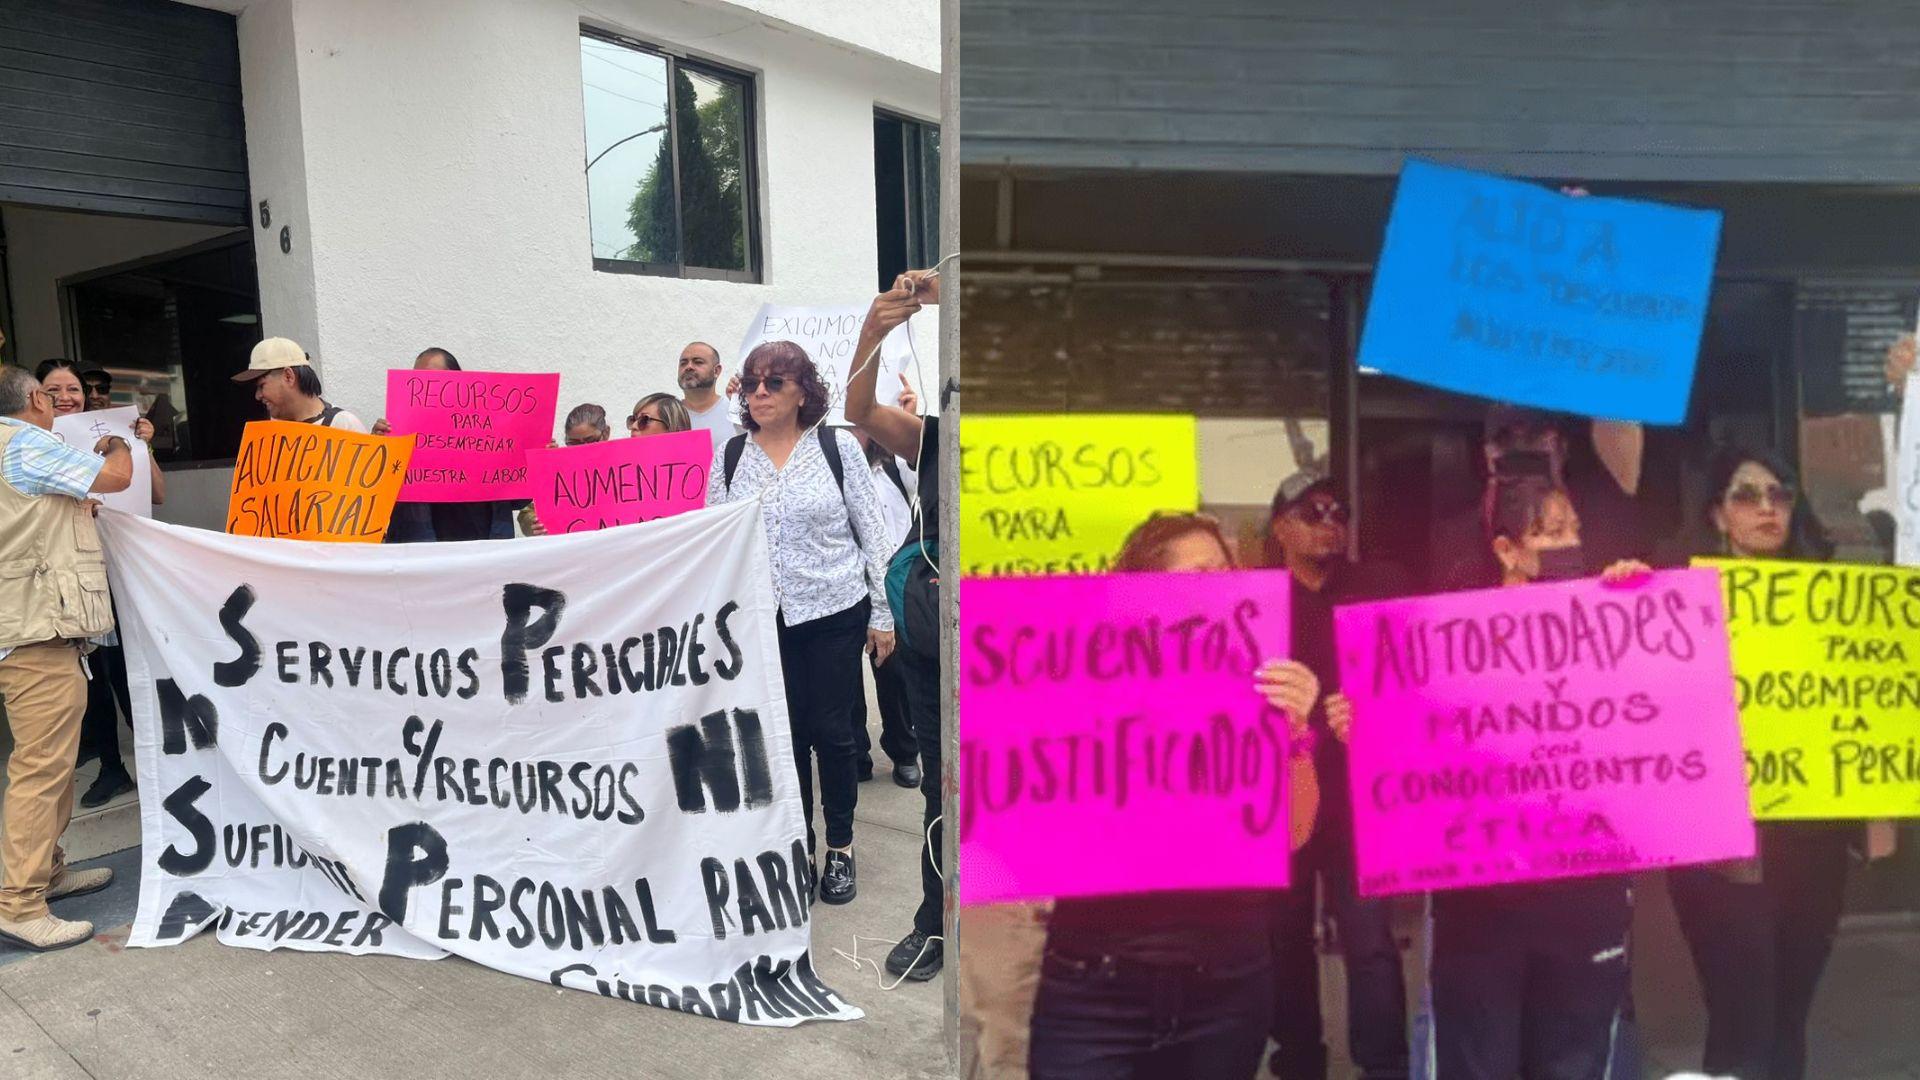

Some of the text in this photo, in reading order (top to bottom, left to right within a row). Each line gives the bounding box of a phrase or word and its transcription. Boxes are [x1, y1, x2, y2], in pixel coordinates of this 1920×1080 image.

[407, 376, 538, 414] RECURSOS
[451, 412, 492, 431] PARA
[415, 432, 514, 452] DESEMPEÑAR
[404, 467, 527, 486] NUESTRA LABOR
[553, 462, 706, 510] AUMENTO
[241, 488, 383, 537] SALARIAL
[980, 507, 1073, 541] PARA
[213, 582, 744, 705] SERVICIOS PERICIALES
[1820, 635, 1907, 664] PARA
[1544, 676, 1567, 698] Y
[1426, 691, 1660, 744] MANDOS
[1831, 714, 1870, 733] LA
[258, 721, 407, 799] CUENTA
[665, 706, 774, 815] NI
[378, 820, 677, 951] PERSONAL
